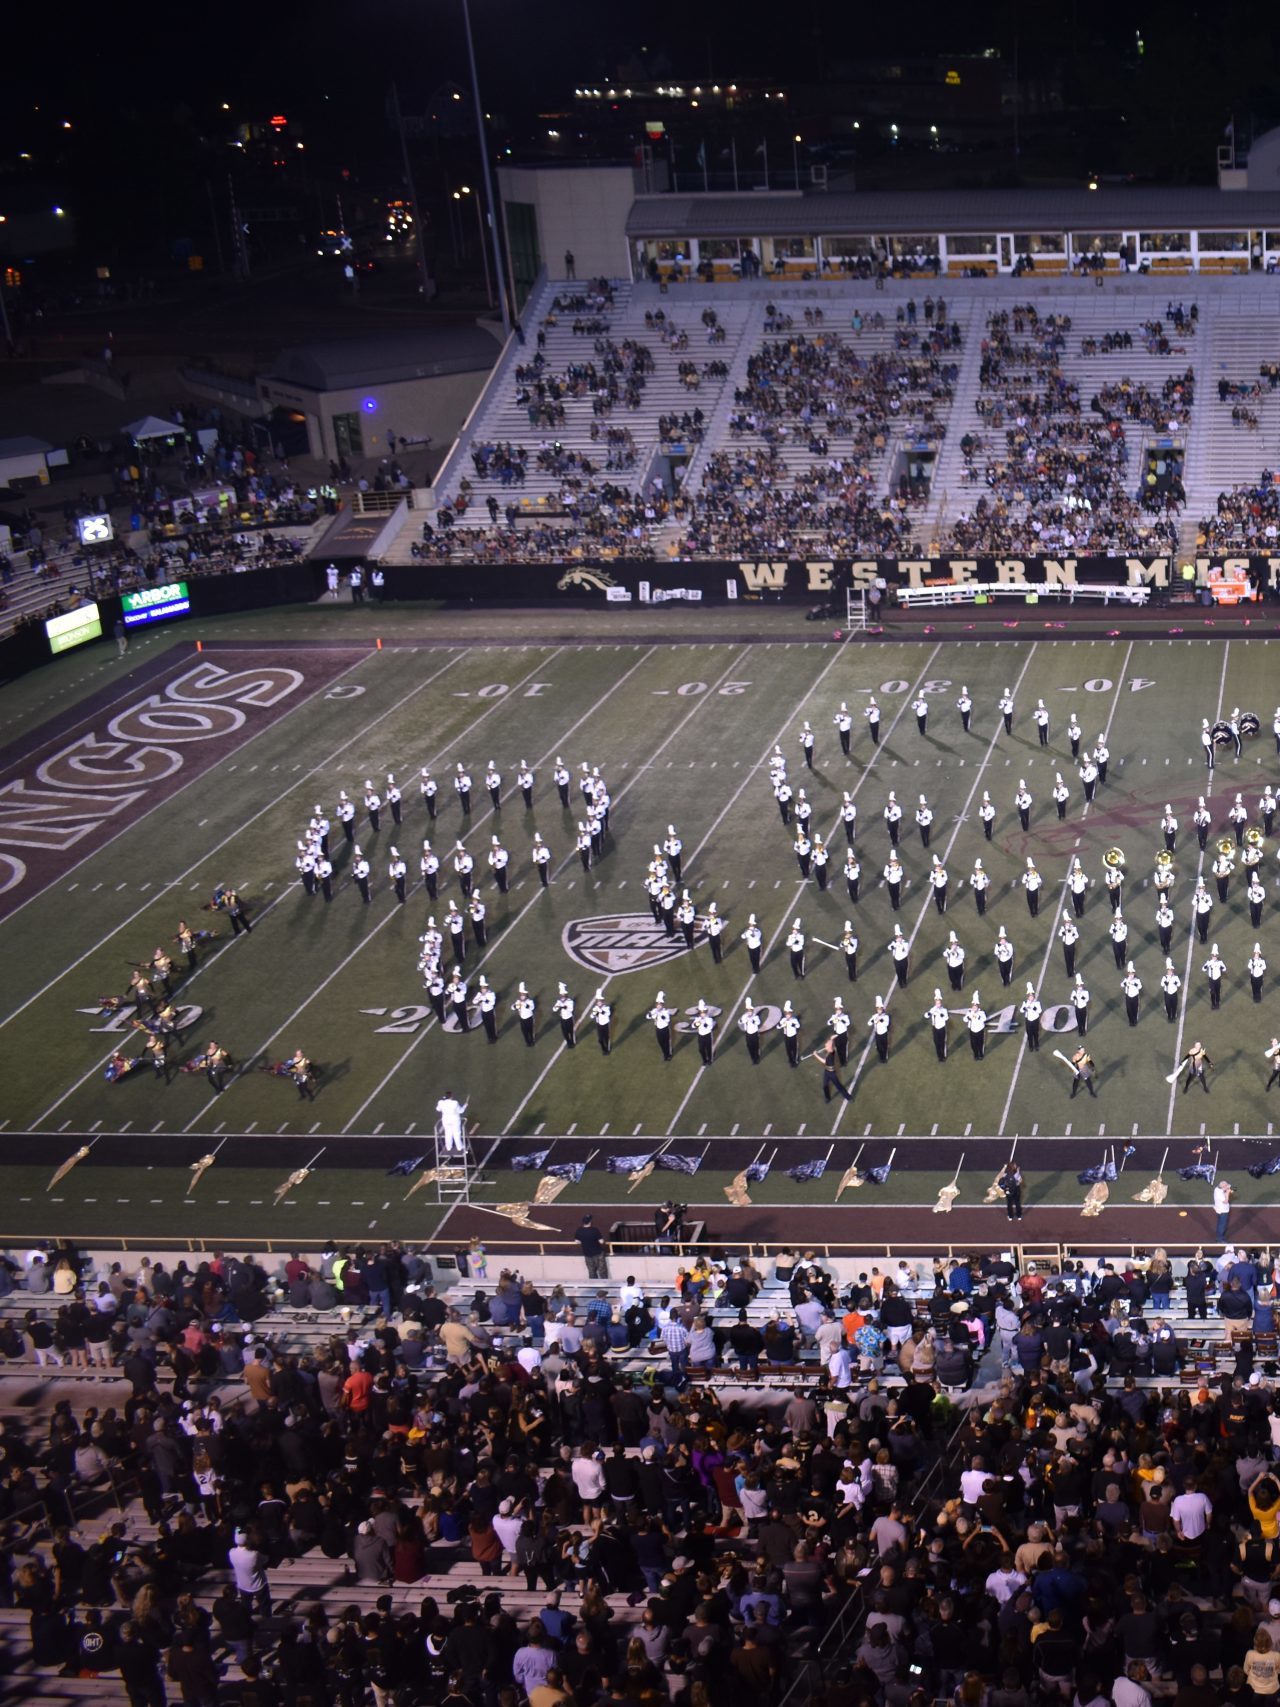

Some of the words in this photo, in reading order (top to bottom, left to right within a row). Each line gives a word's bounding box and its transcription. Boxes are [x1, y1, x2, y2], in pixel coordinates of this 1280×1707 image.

[739, 559, 1078, 591] WESTERN
[128, 584, 181, 606] ARBOR
[477, 683, 553, 698] 10
[676, 681, 753, 696] 20
[879, 679, 953, 695] 30
[1083, 678, 1157, 693] 40
[374, 1005, 484, 1033] 20
[673, 1004, 782, 1033] 30
[983, 1004, 1080, 1033] 40
